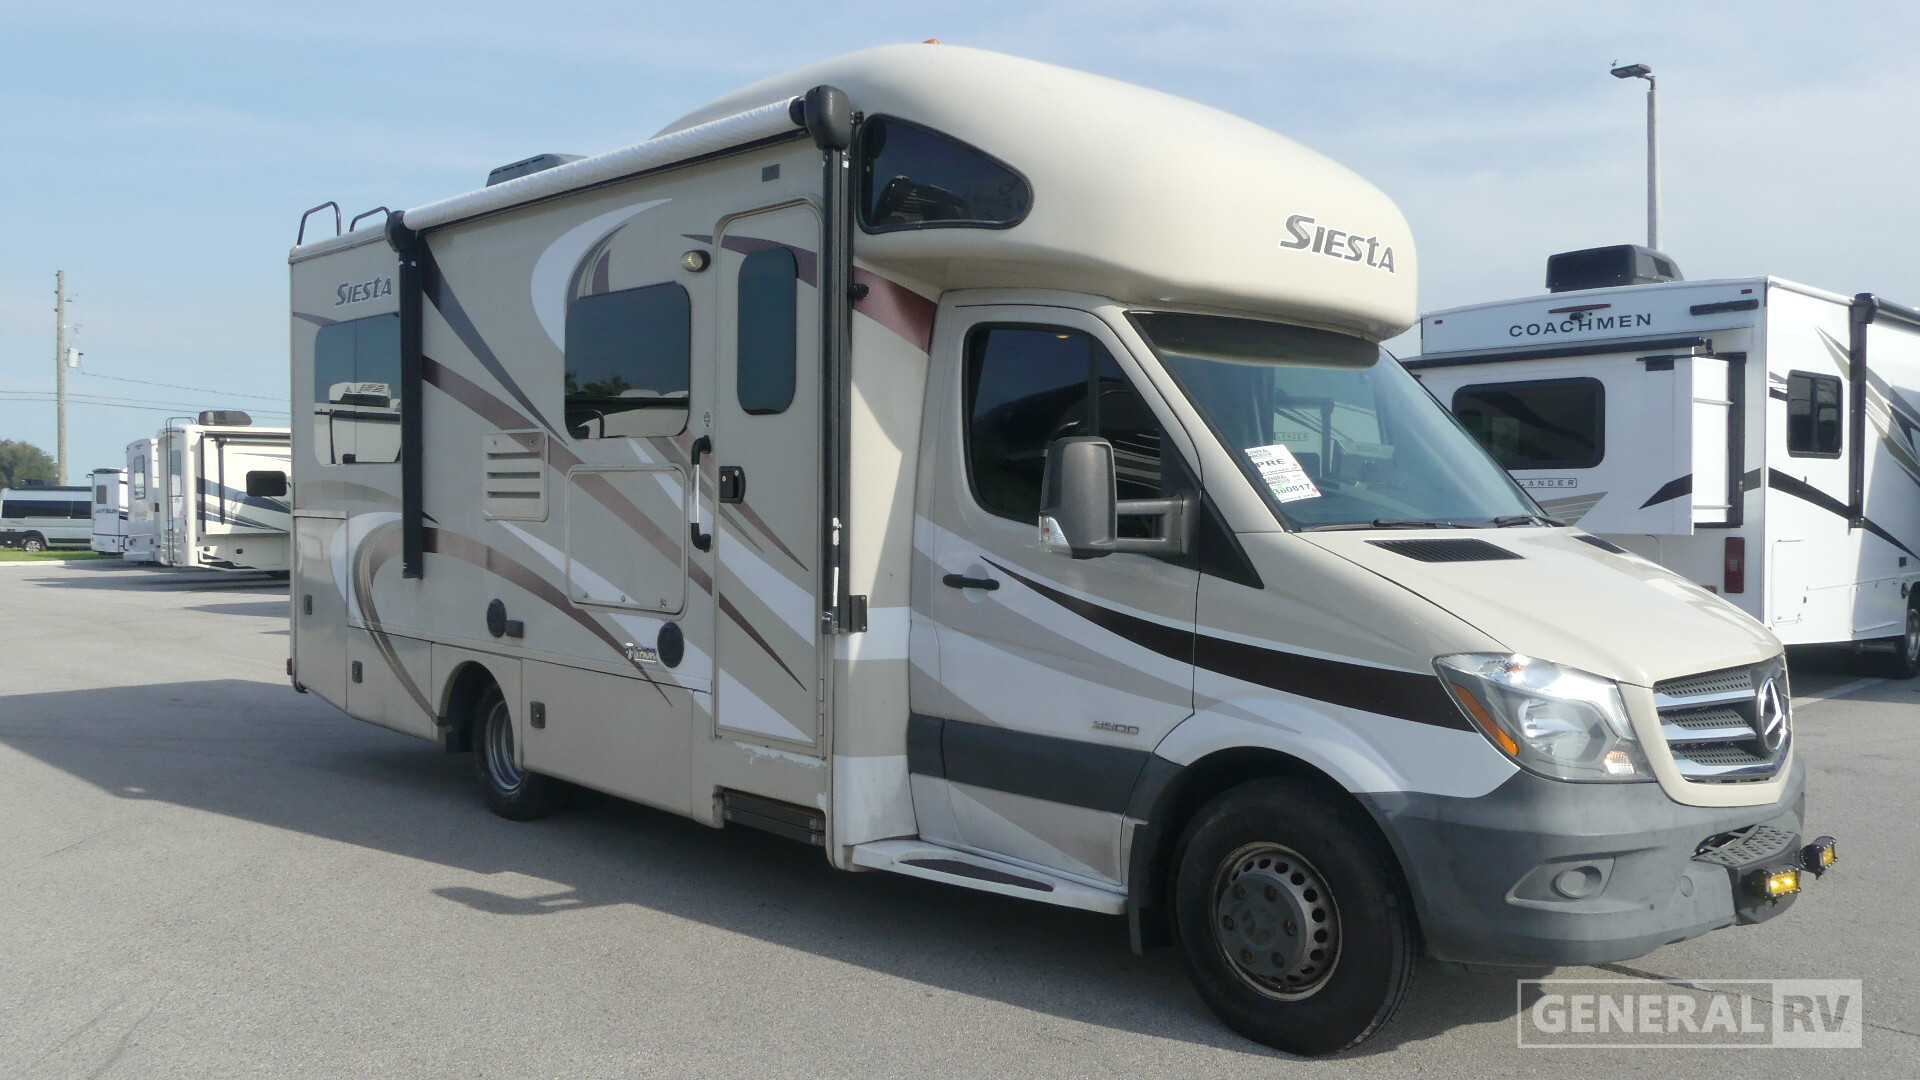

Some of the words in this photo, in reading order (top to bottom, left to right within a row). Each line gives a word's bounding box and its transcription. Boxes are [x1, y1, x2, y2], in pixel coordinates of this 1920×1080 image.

[1509, 313, 1652, 337] COACHMEN
[1255, 458, 1286, 468] PRE
[1092, 720, 1140, 735] 3500
